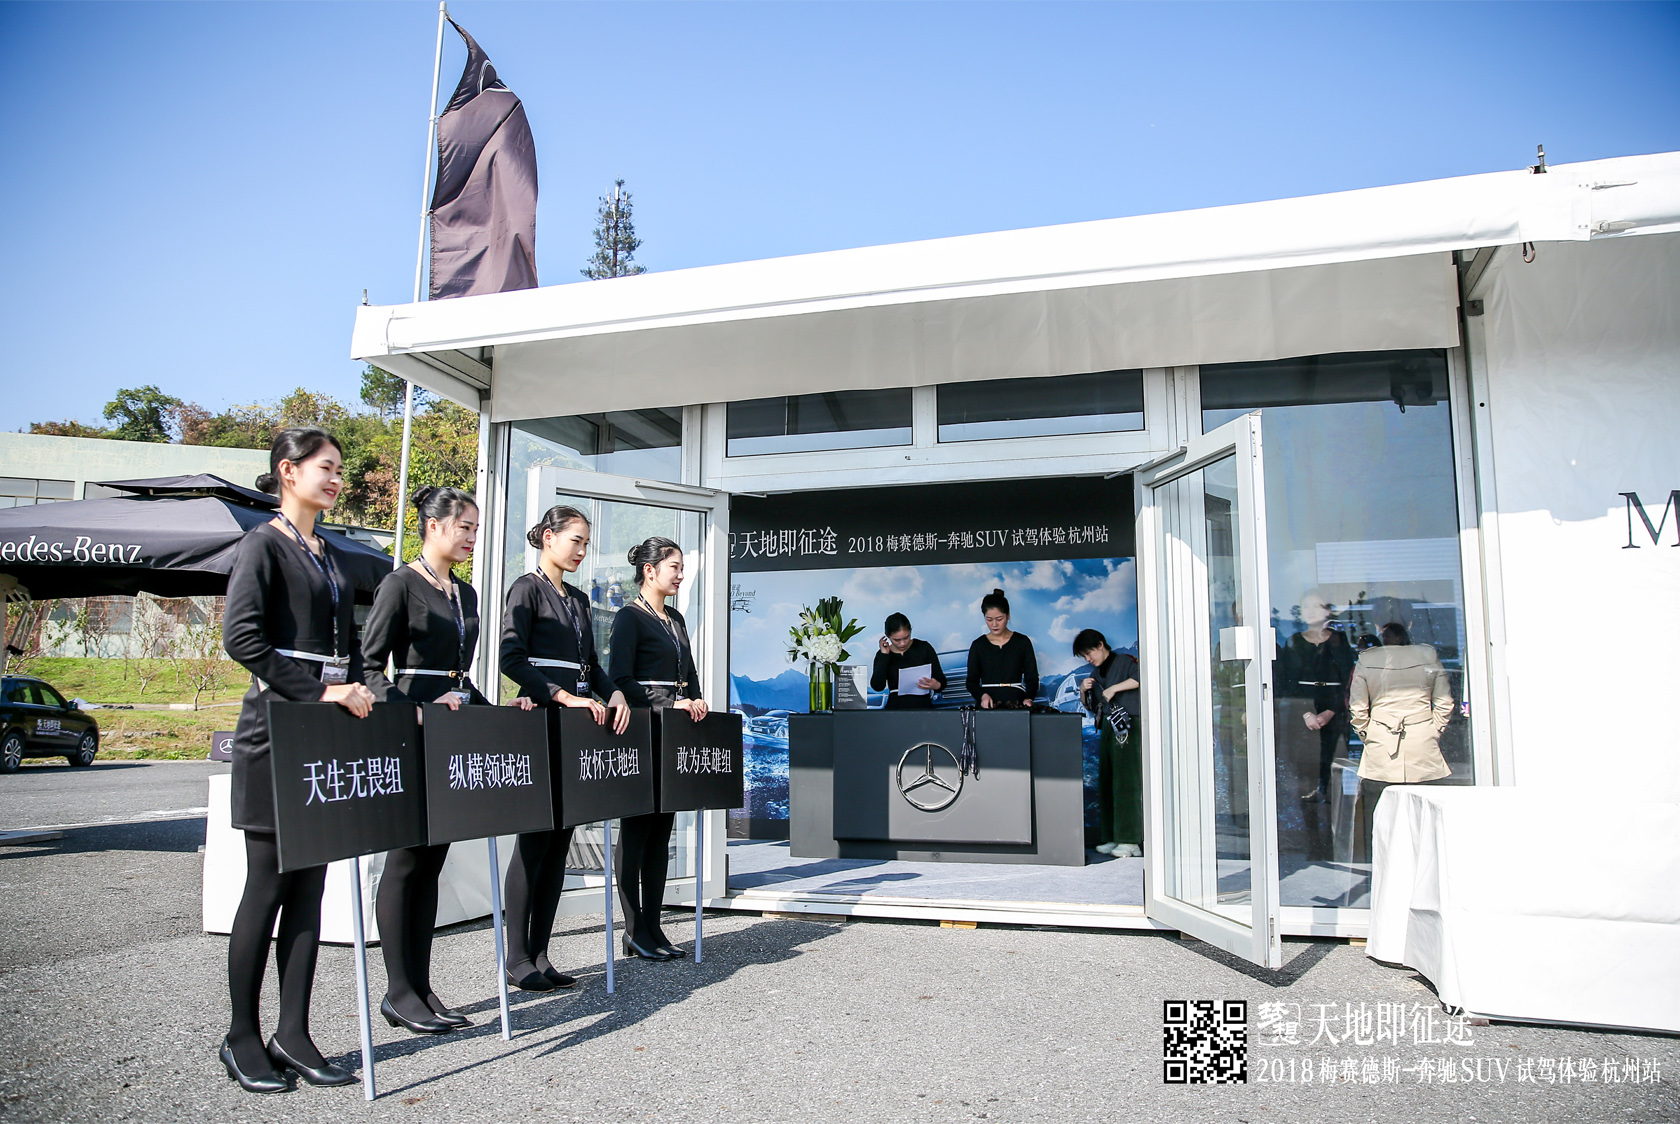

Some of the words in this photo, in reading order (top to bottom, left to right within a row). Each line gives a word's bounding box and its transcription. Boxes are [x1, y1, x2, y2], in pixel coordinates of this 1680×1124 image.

[0, 535, 143, 564] edes-Benz
[739, 526, 838, 559] 天地即征途
[848, 536, 883, 553] 2018
[448, 753, 533, 790] 纵横领域组
[579, 747, 640, 781] 放怀天地组
[676, 746, 732, 774] 敢为英雄组
[303, 756, 404, 806] 天生无畏组
